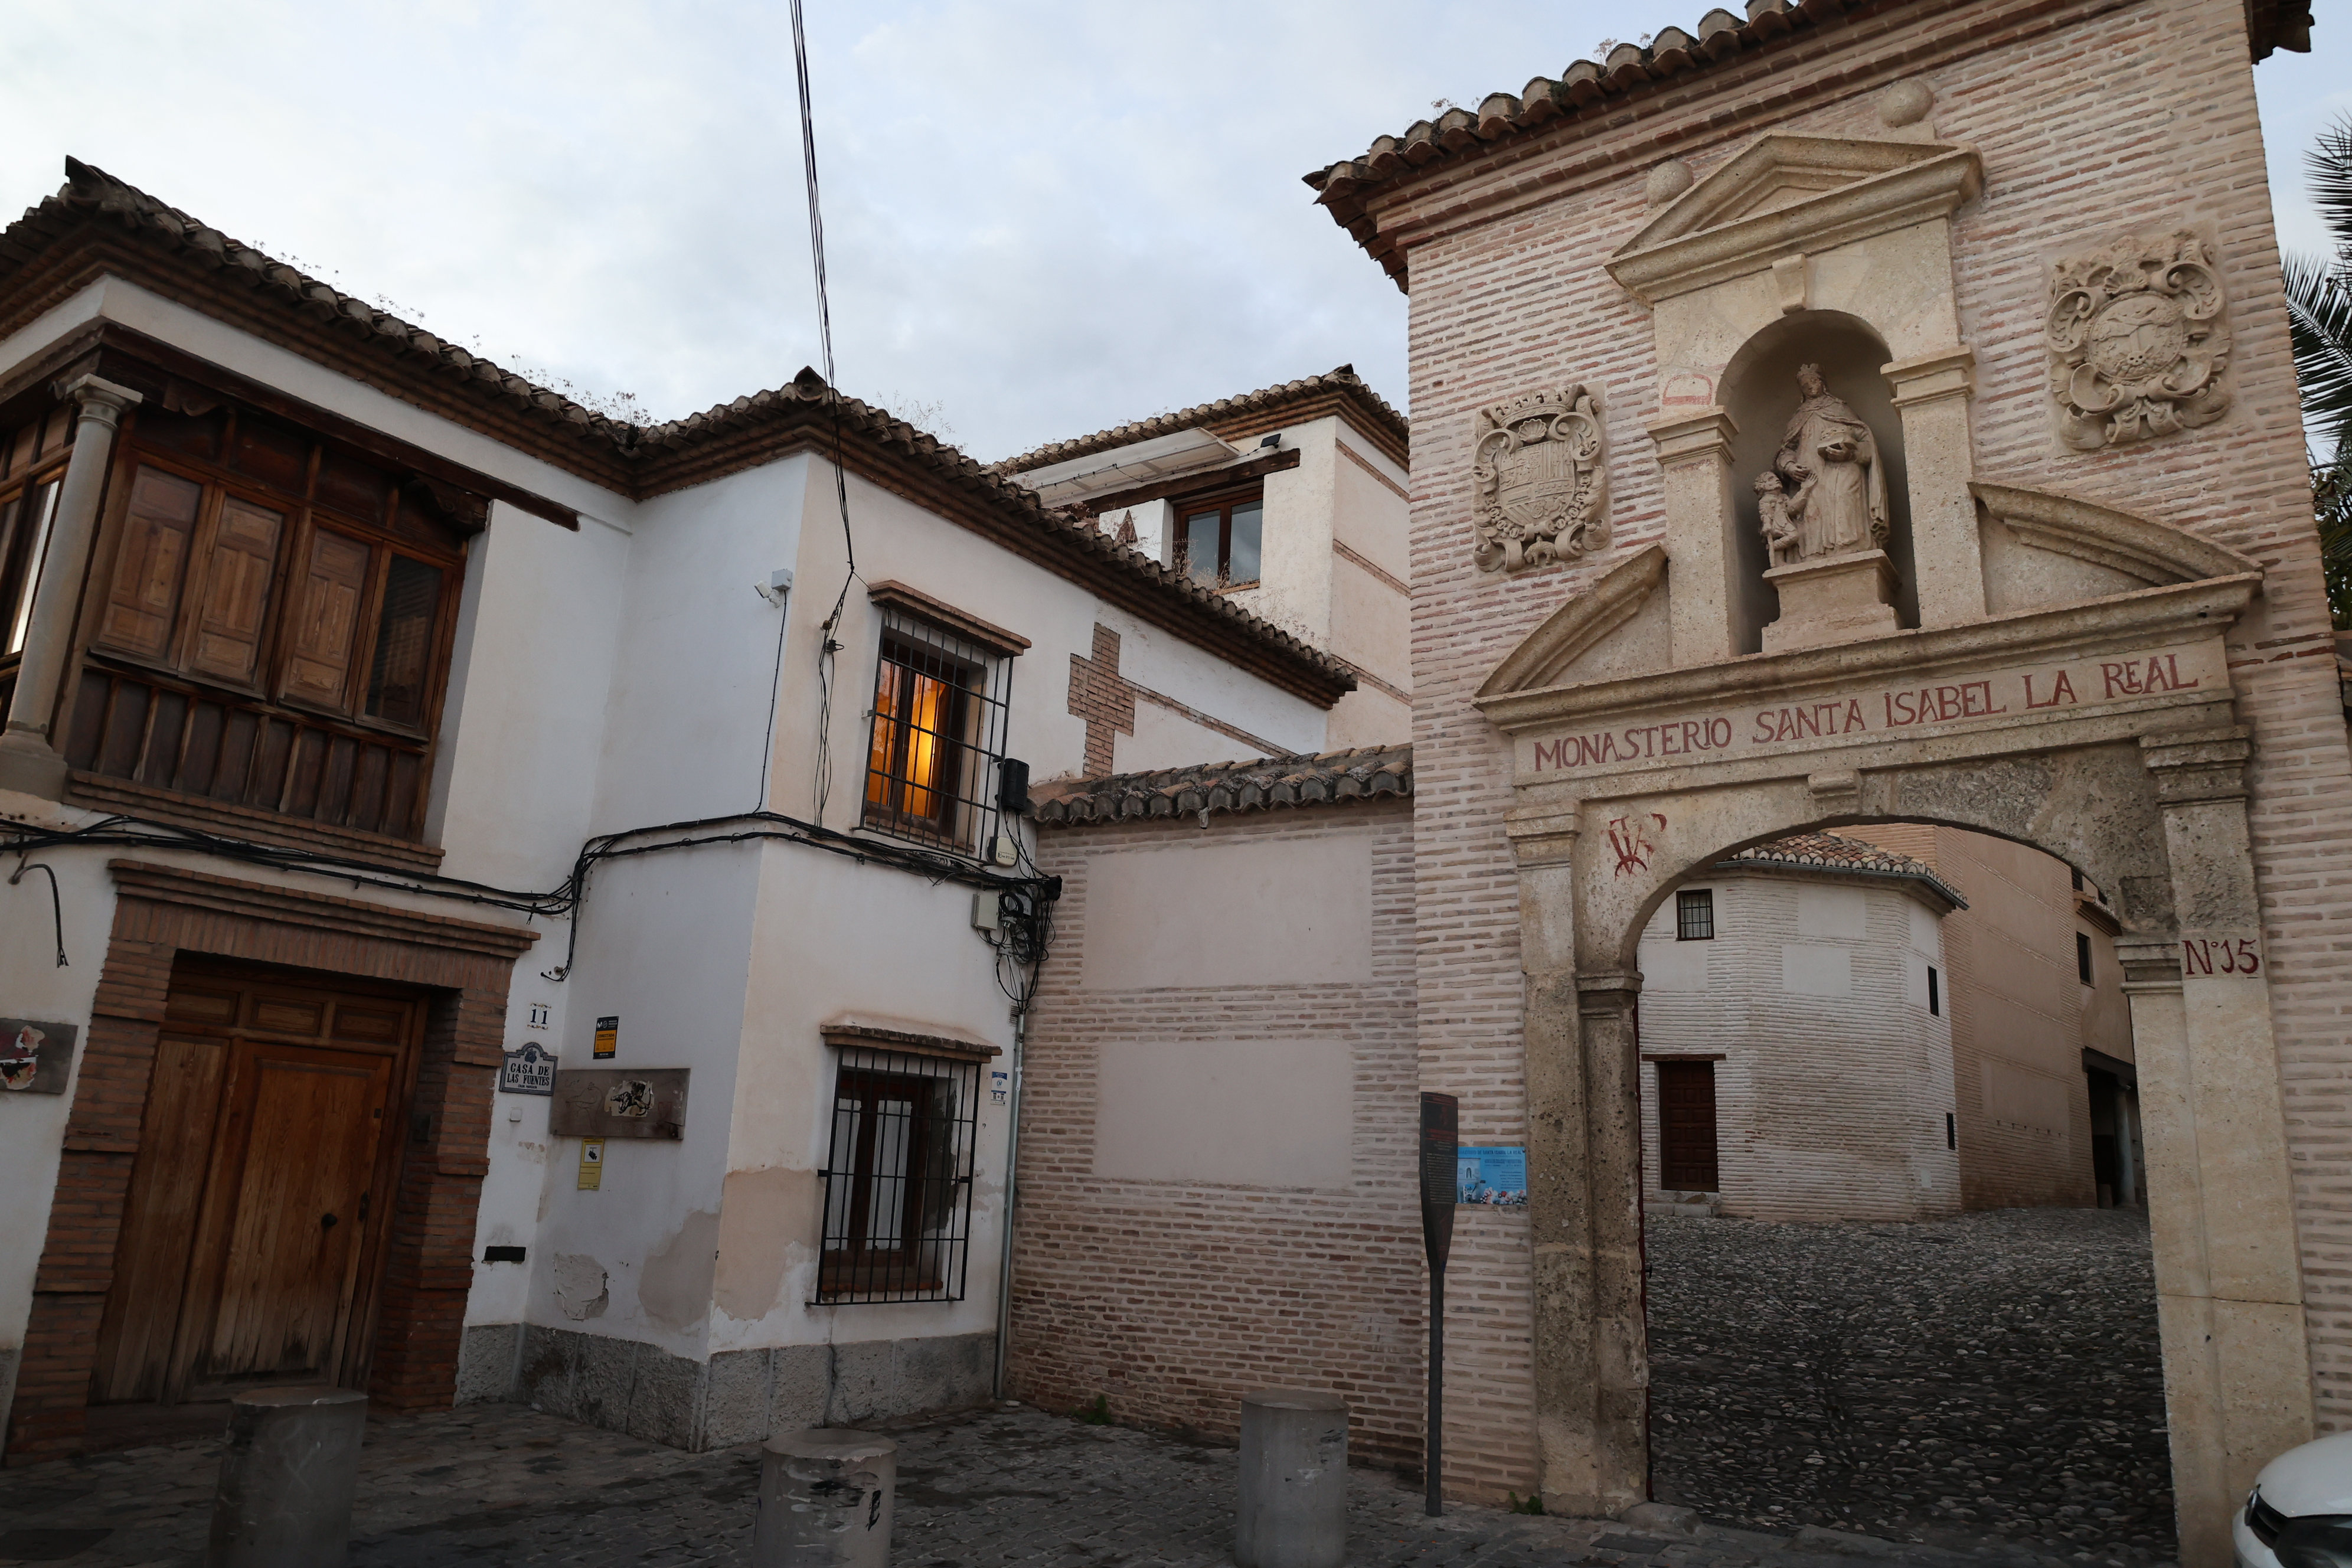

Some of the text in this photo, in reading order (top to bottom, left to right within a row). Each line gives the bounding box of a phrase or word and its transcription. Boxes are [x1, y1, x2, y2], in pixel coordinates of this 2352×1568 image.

[1534, 653, 2199, 771] MONASTERIO SANTA ISABEL LA REAL
[530, 1008, 547, 1025] 11
[510, 1063, 550, 1076] CASA DE
[507, 1073, 550, 1087] LAS FUENTES
